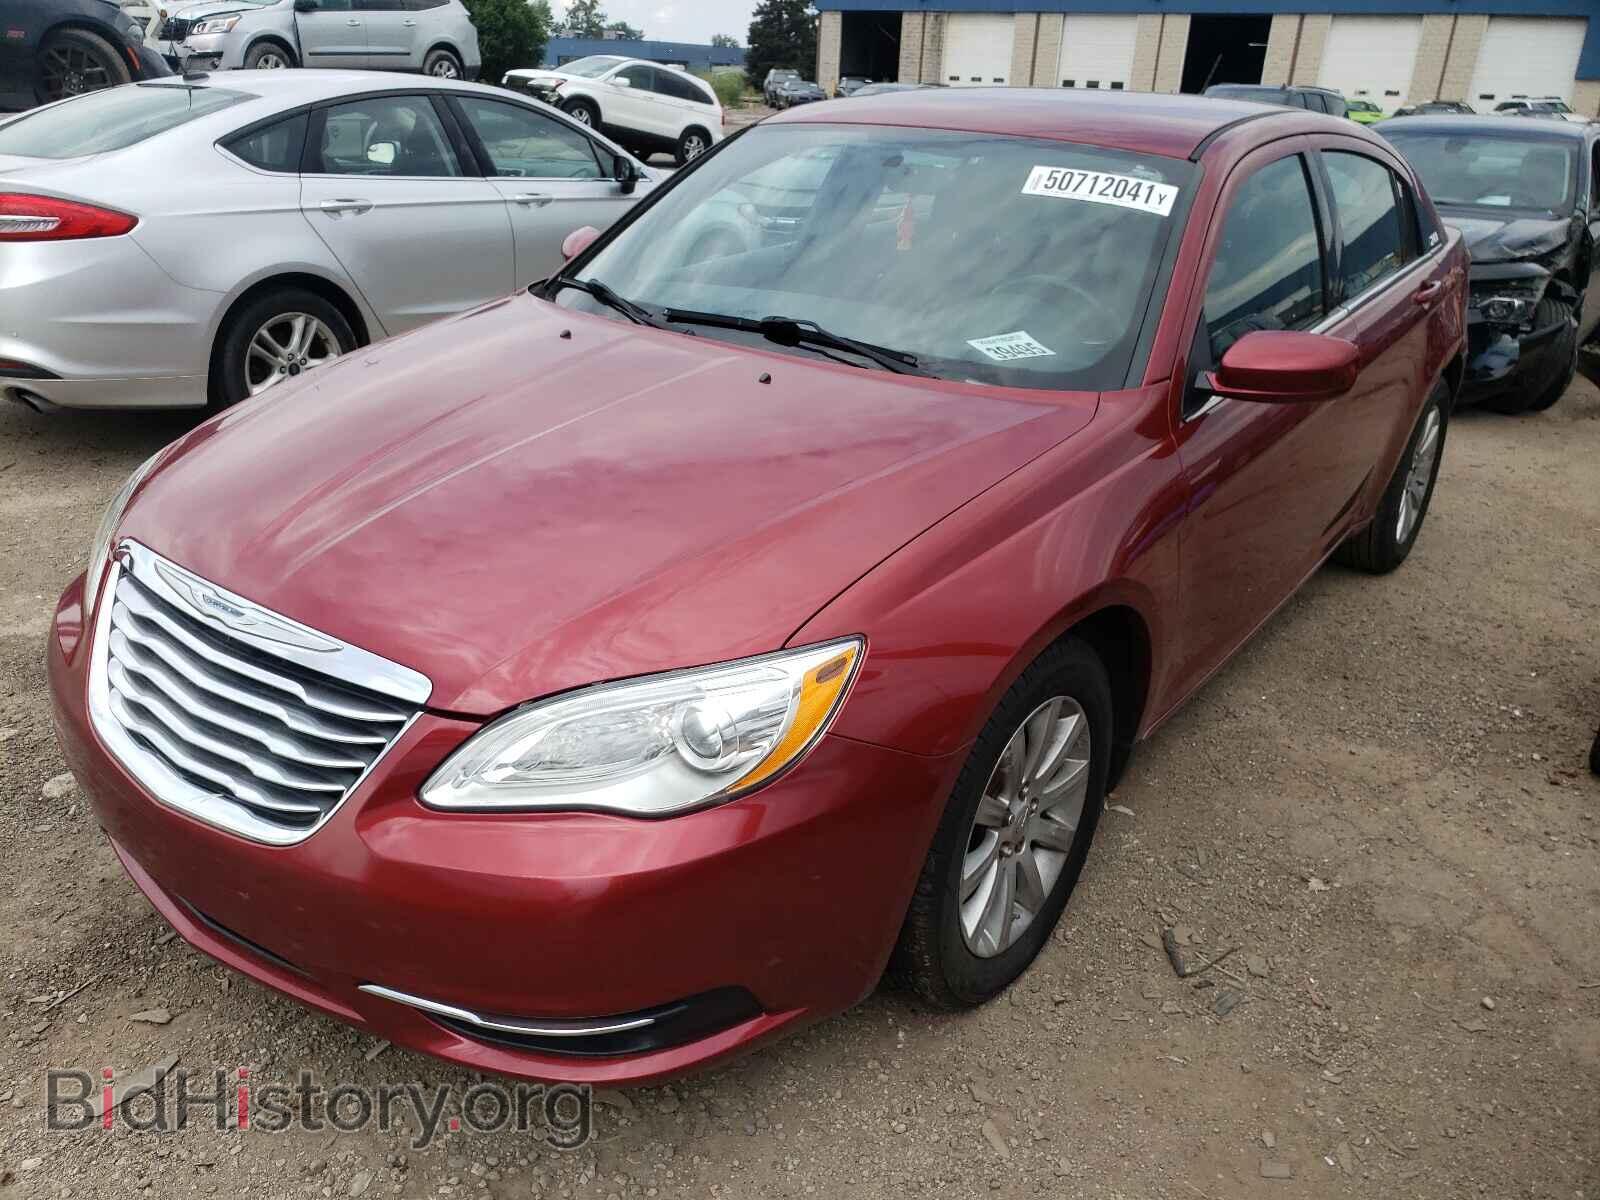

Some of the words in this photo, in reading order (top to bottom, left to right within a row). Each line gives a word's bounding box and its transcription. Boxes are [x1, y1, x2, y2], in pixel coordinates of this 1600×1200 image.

[1043, 170, 1155, 204] 50712041
[1157, 192, 1168, 206] Y
[985, 342, 1048, 359] 39495
